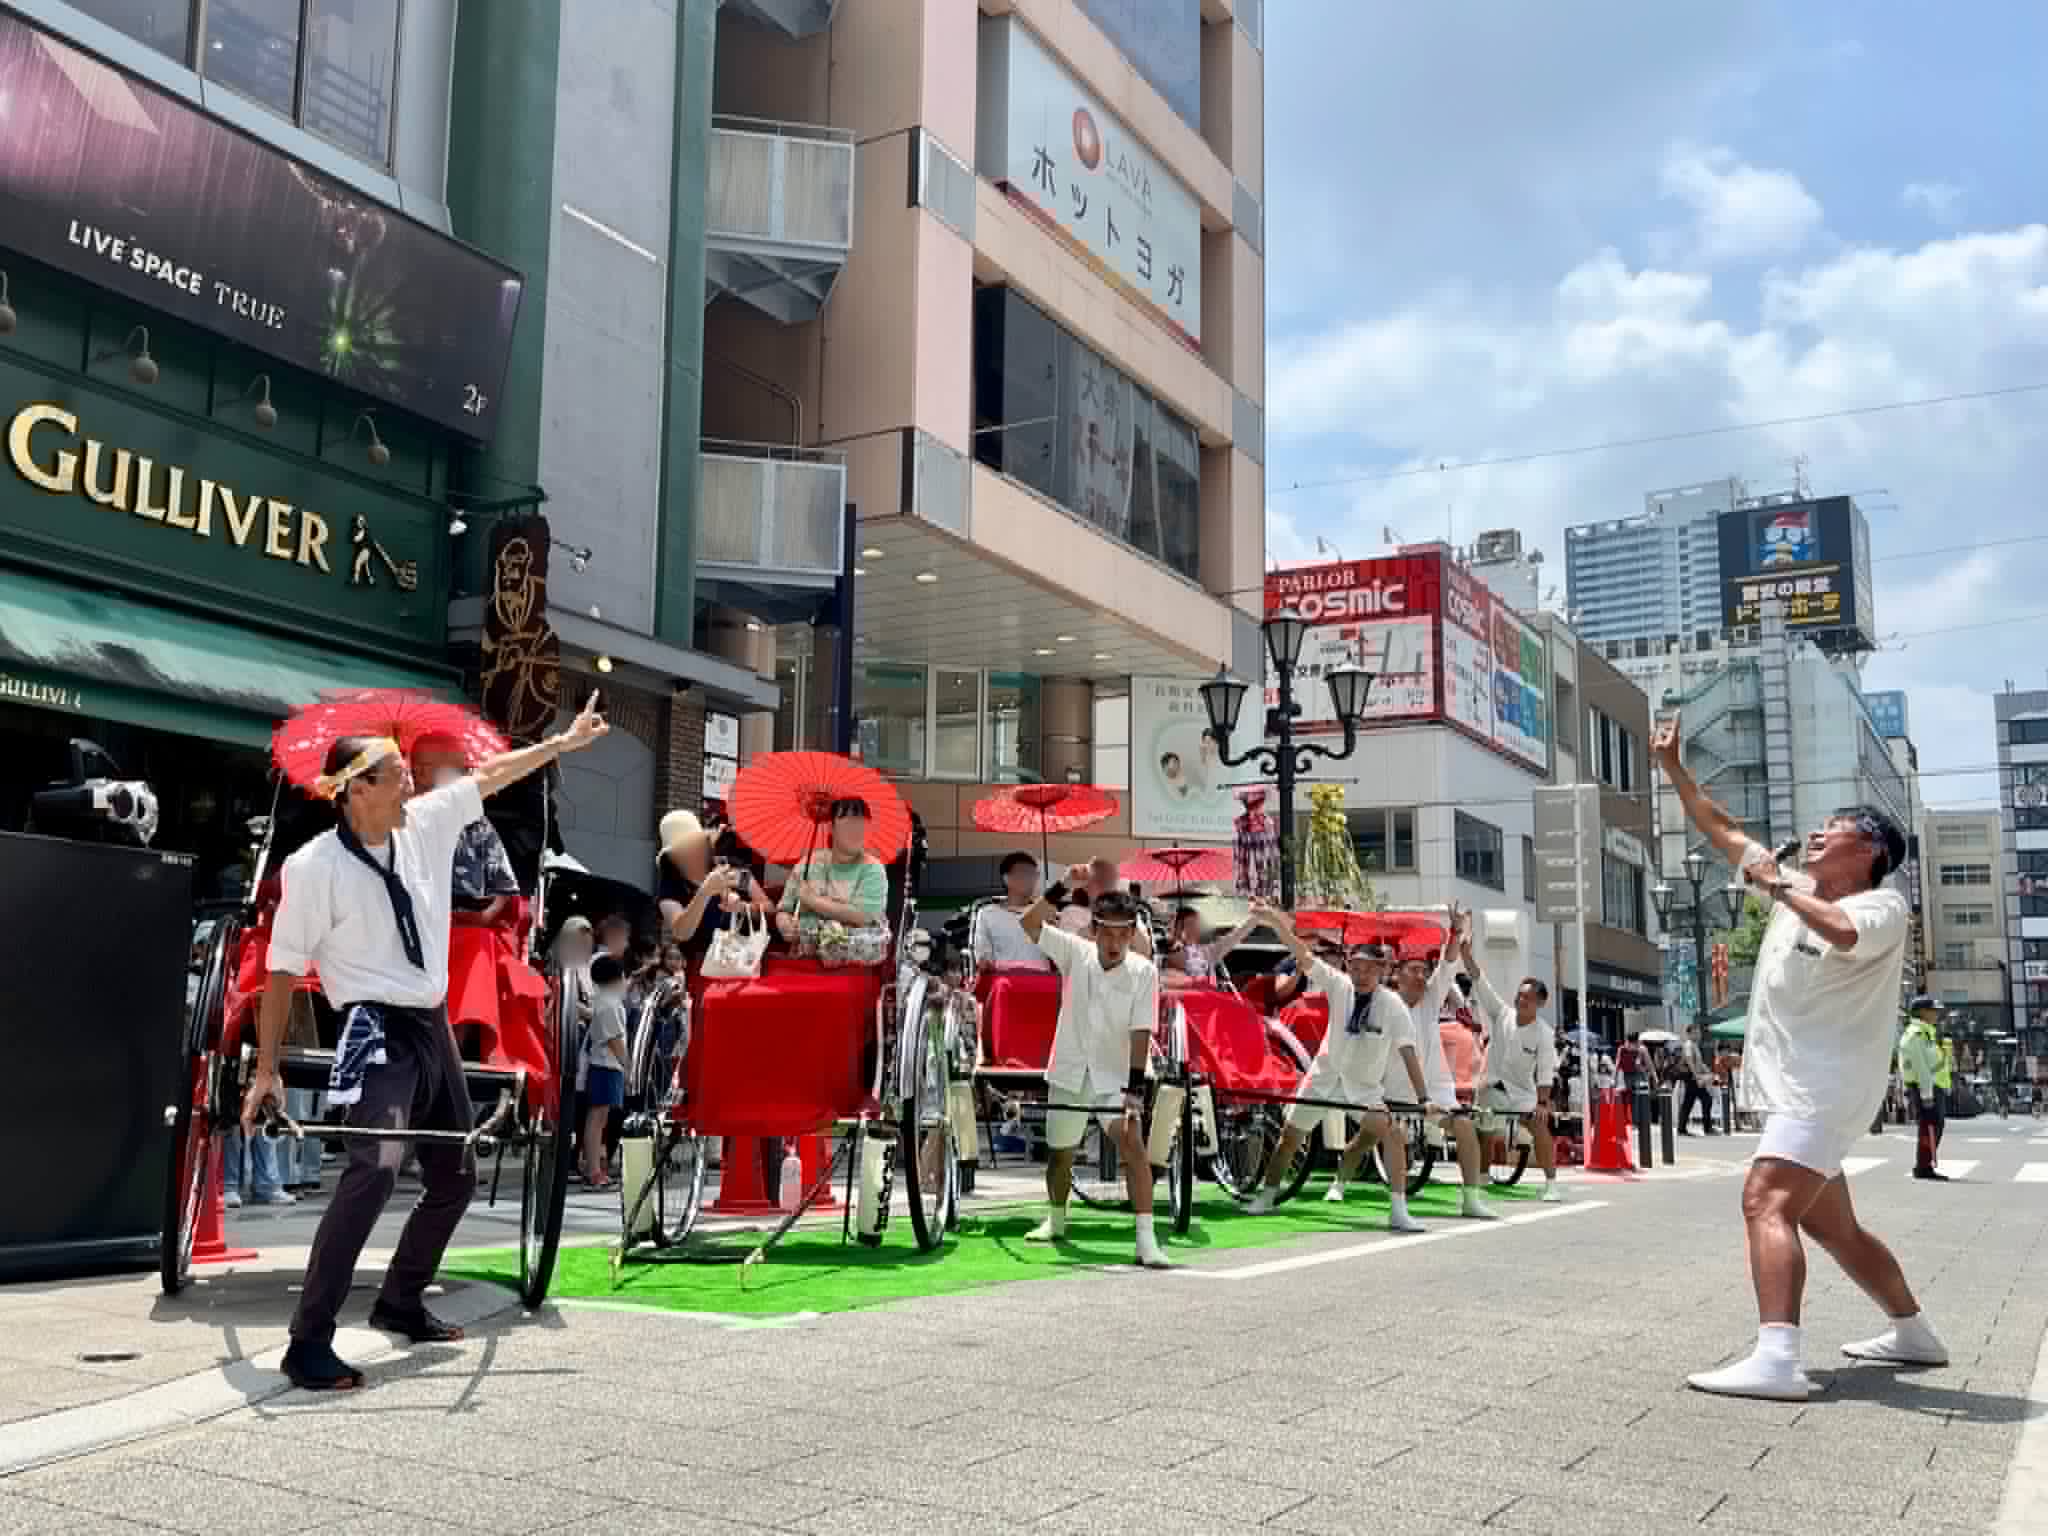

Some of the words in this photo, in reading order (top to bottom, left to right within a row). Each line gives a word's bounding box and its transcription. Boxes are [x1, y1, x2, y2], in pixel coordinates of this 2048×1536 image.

[1031, 144, 1185, 305] ホットヨガ
[1105, 138, 1152, 201] LAVA
[68, 219, 126, 263] LIVE
[129, 248, 202, 295] SPACE
[214, 281, 285, 329] TRUE
[8, 404, 331, 573] GULLIVER
[1279, 570, 1355, 592] PARLOR
